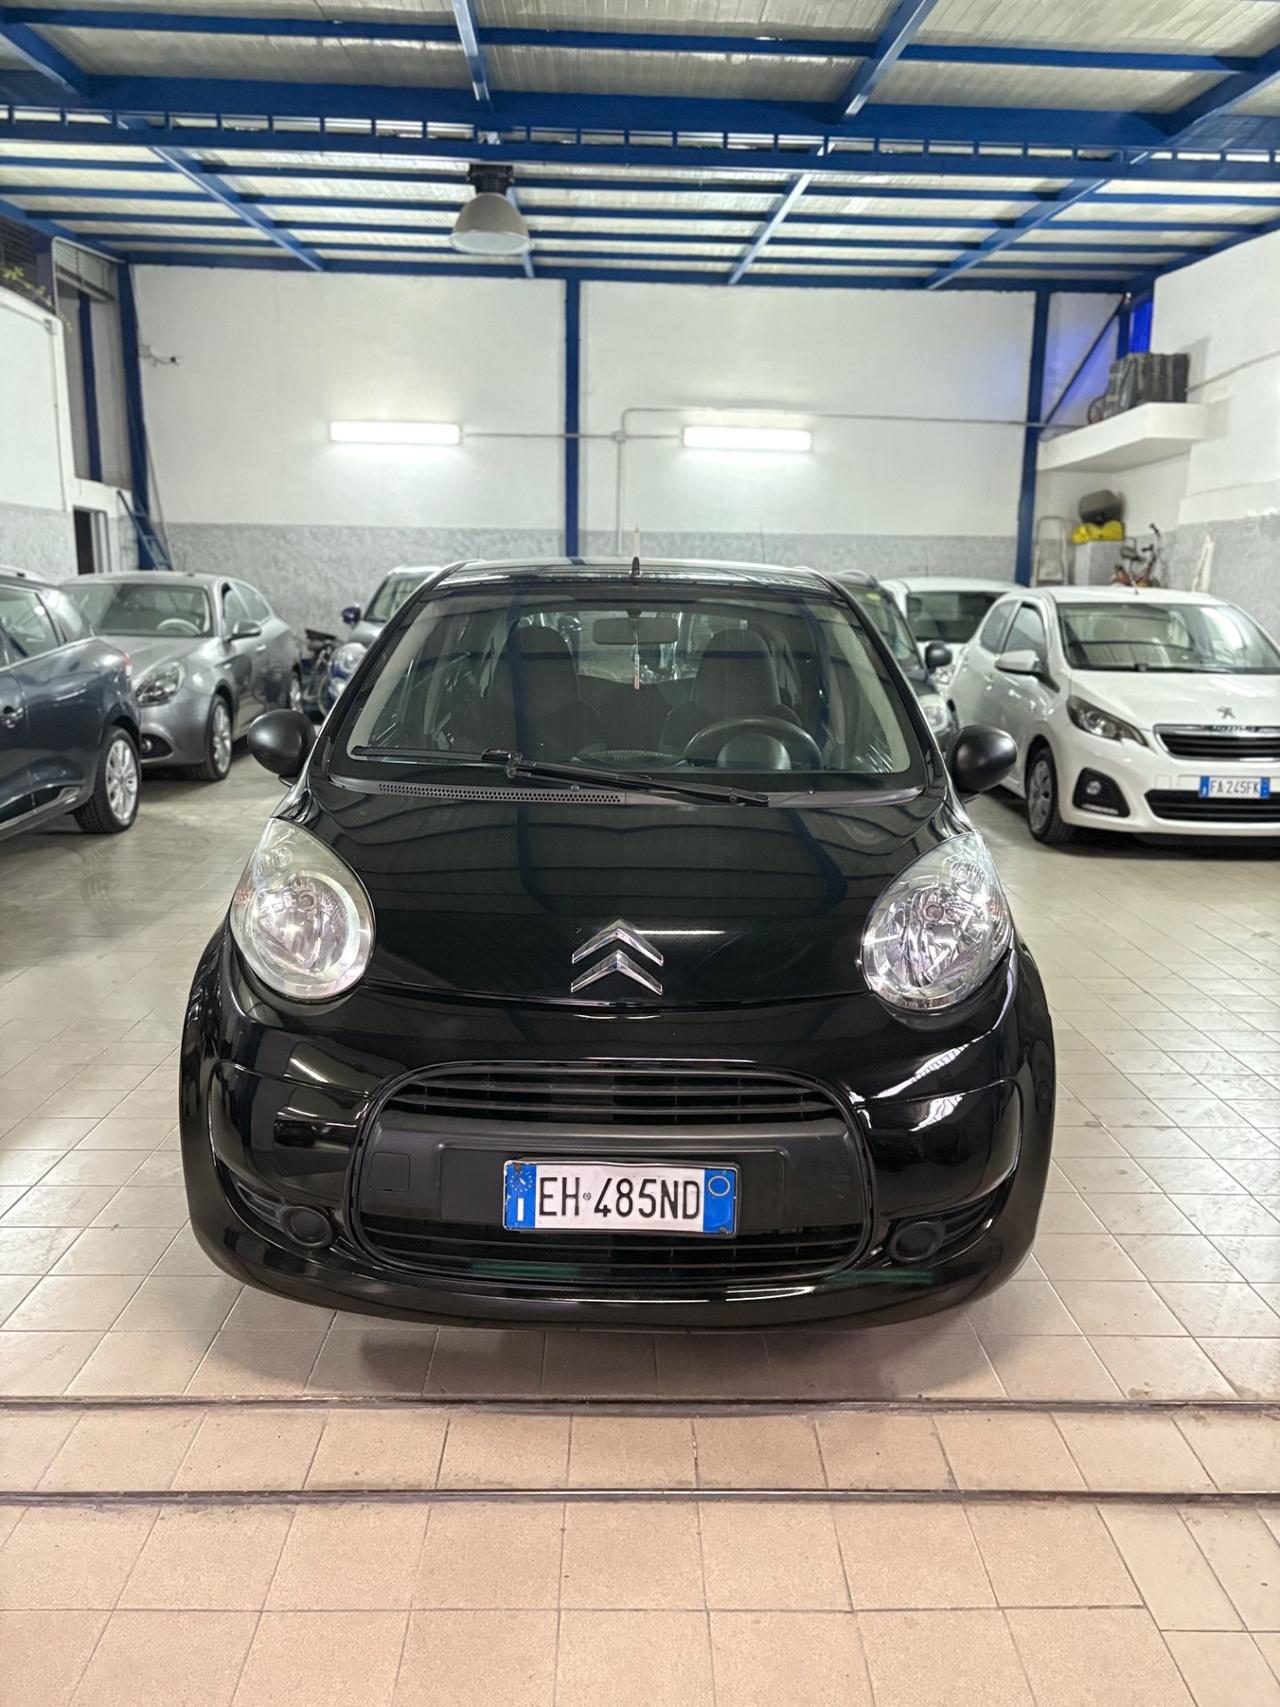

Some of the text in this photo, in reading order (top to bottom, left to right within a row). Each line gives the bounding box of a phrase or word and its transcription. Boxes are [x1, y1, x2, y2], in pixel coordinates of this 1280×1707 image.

[1210, 780, 1224, 794] FA
[538, 1176, 701, 1220] EH 485ND
